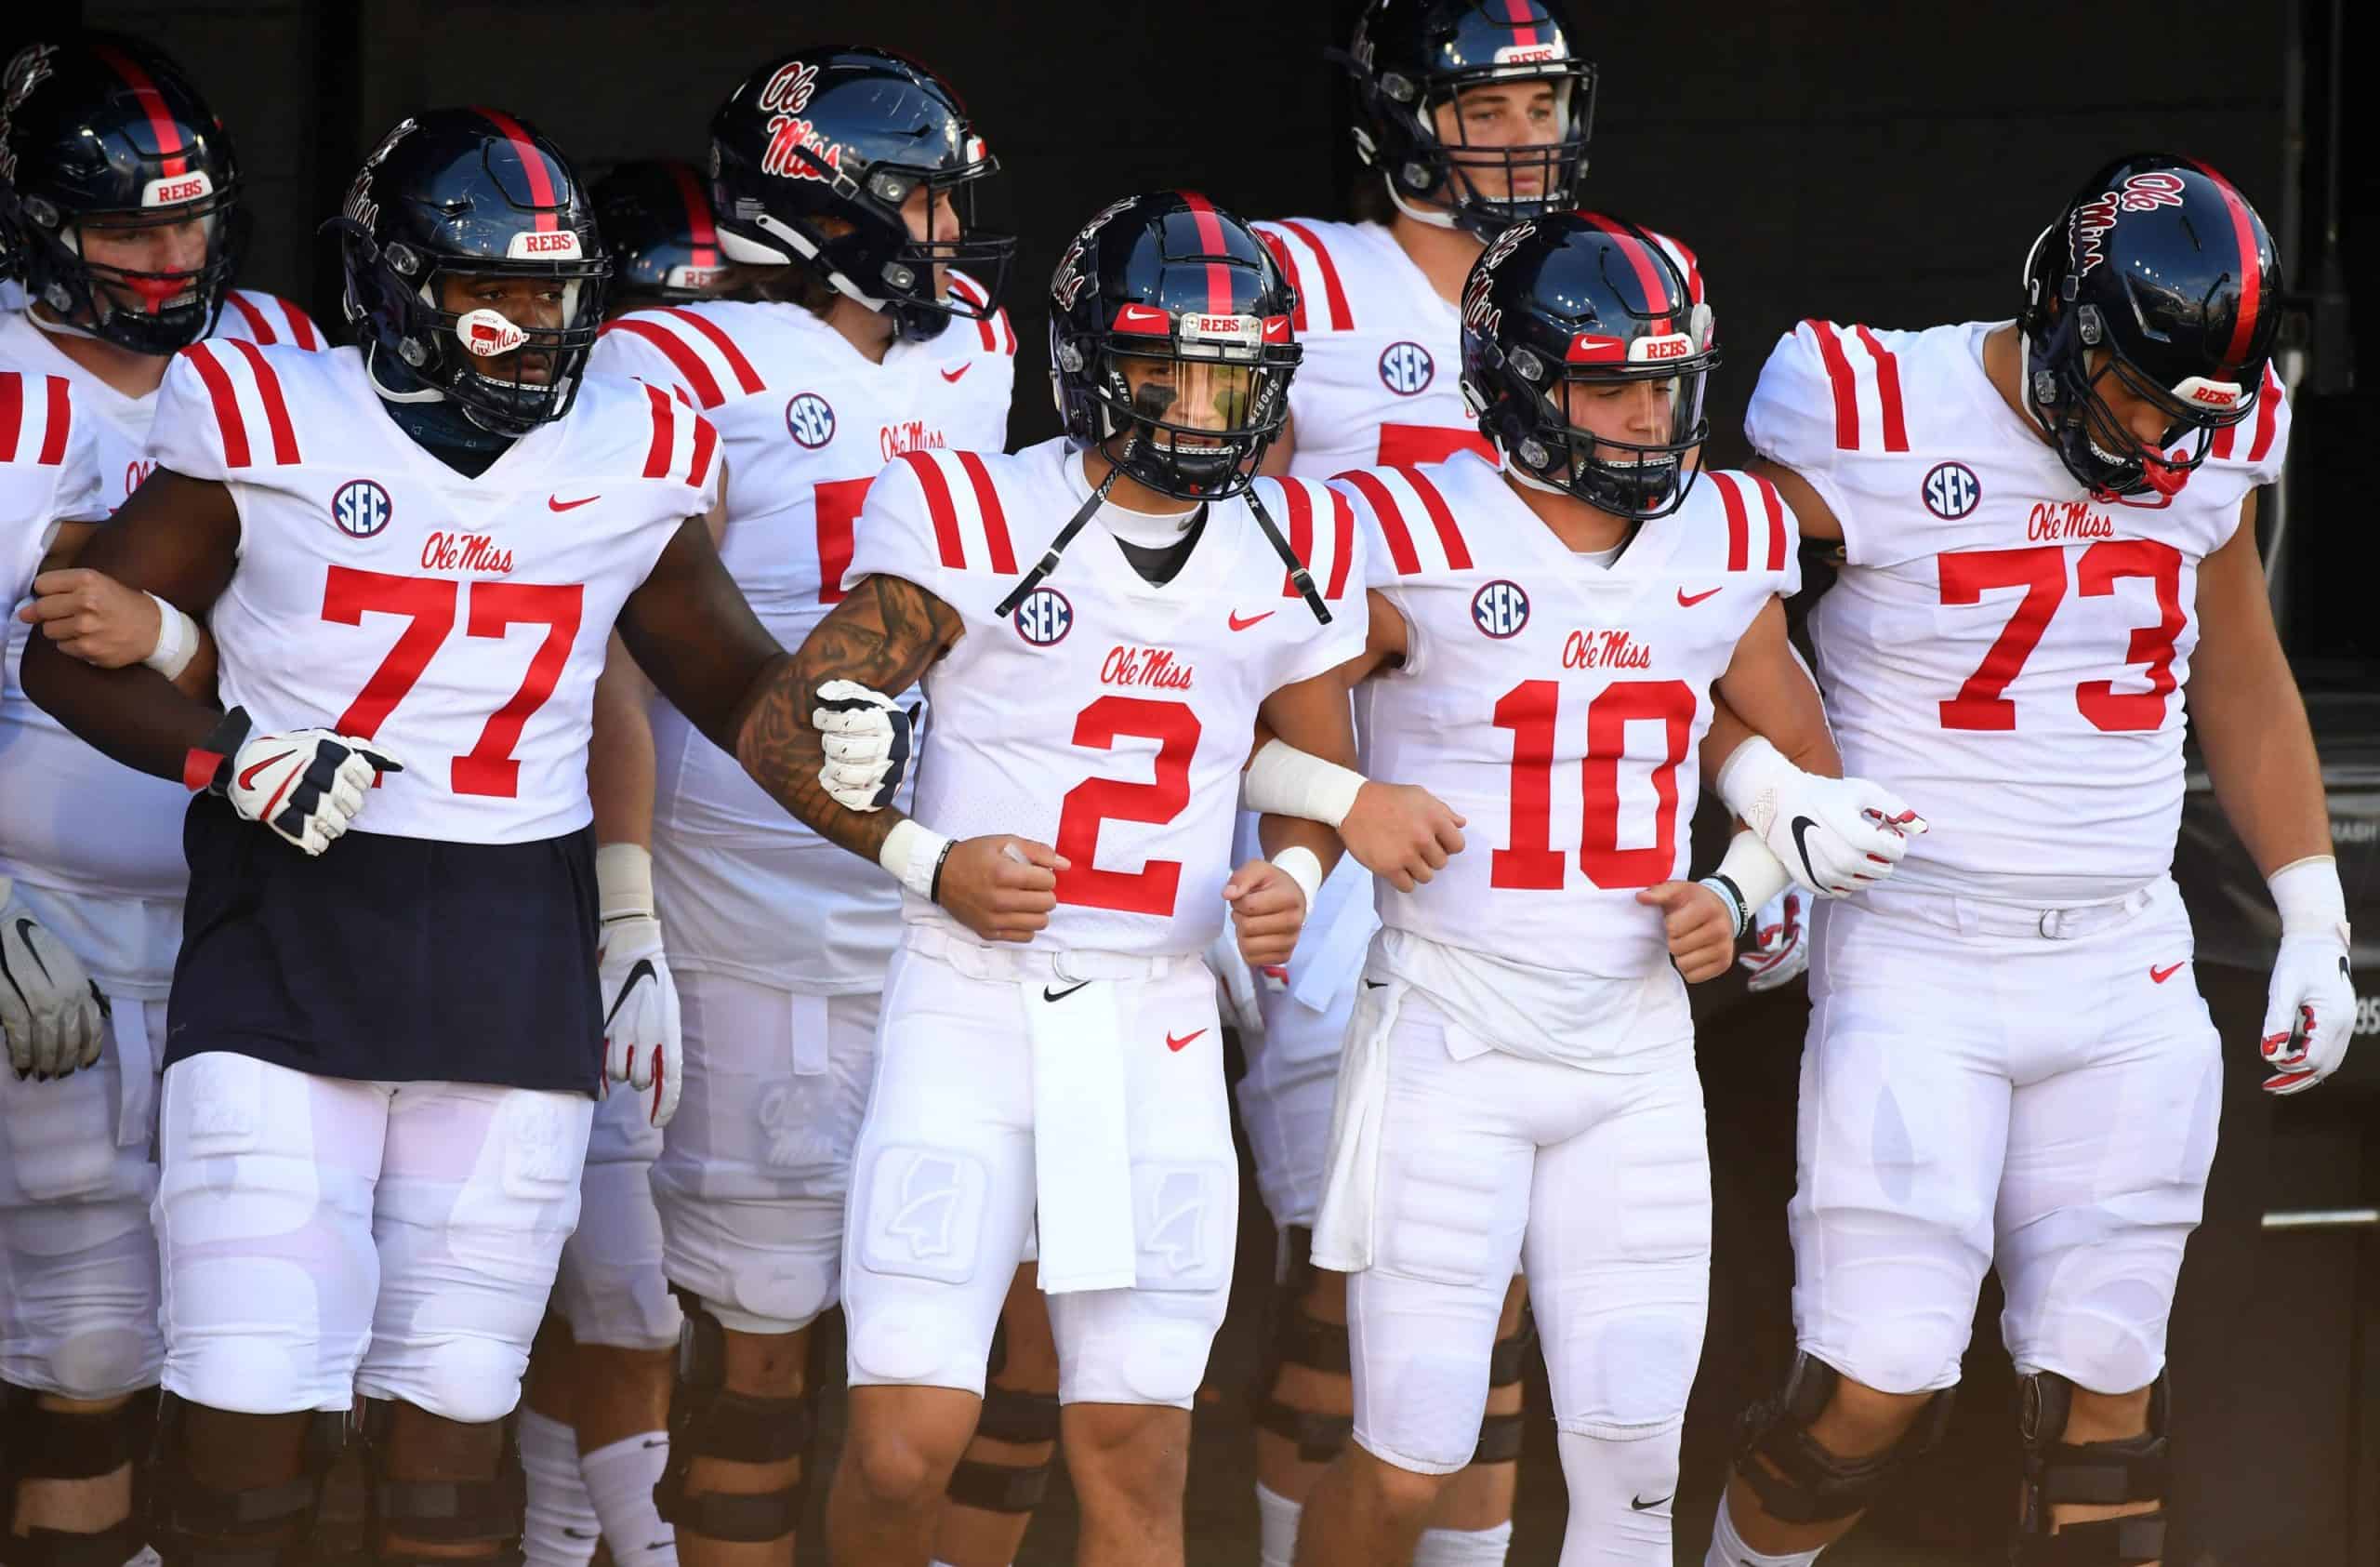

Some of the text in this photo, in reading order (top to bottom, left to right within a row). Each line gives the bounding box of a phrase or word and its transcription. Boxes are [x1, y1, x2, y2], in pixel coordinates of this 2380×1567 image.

[760, 60, 819, 113] Ole
[158, 179, 203, 203] REBS
[2121, 172, 2185, 212] Ole
[526, 233, 573, 253] REBS
[1199, 318, 1240, 333] REBS
[1646, 339, 1688, 360] REBS
[1379, 343, 1432, 393] SEC
[787, 393, 835, 447] SEC
[2192, 386, 2236, 405] REBS
[334, 481, 390, 537] SEC
[1923, 464, 1980, 519] SEC
[2028, 502, 2115, 540] Ole Miss
[421, 531, 513, 574] Ole Miss
[1017, 590, 1070, 644] SEC
[1473, 581, 1527, 638] SEC
[1562, 630, 1651, 669] Ole Miss
[1937, 538, 2188, 733] 73
[321, 564, 584, 798] 77
[1100, 645, 1193, 690] Ole Miss
[1055, 694, 1202, 917] 2
[1490, 680, 1697, 890] 10
